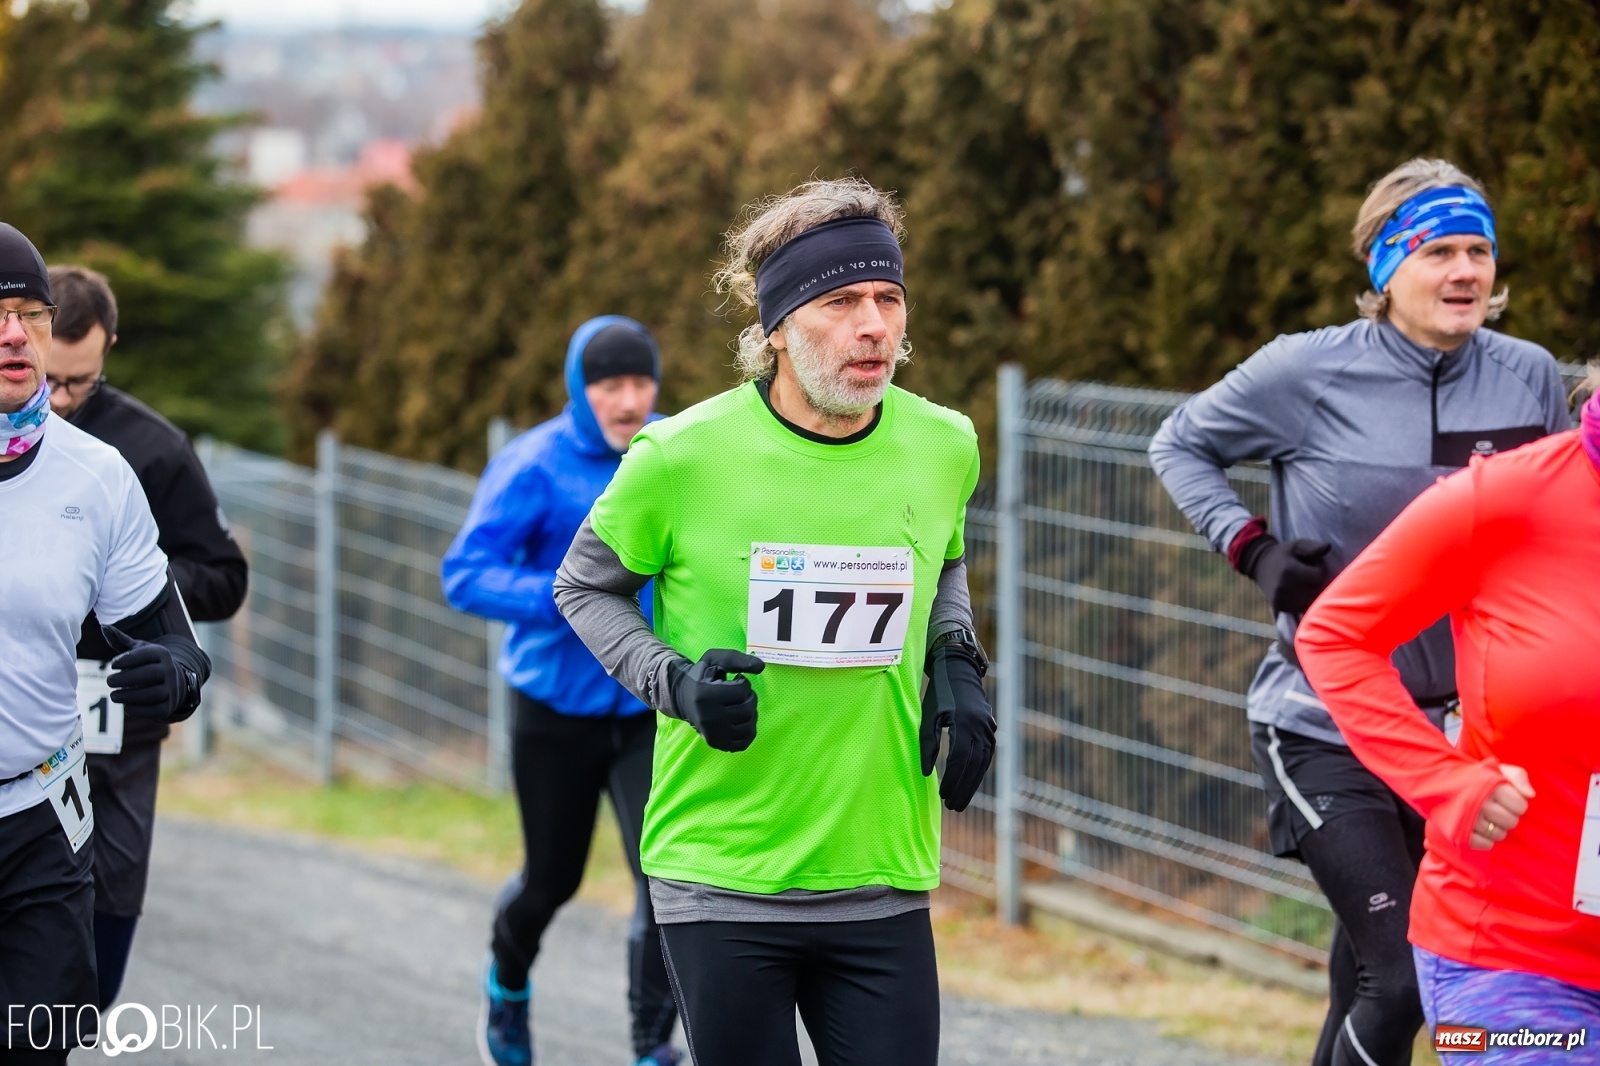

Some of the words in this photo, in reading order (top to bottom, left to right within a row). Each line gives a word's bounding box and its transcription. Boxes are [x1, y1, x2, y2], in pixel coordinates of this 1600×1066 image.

[821, 265, 845, 279] LIKE
[870, 260, 891, 268] ONE
[813, 559, 908, 572] www.personalbest.pl
[763, 588, 904, 644] 177
[89, 697, 108, 733] 1
